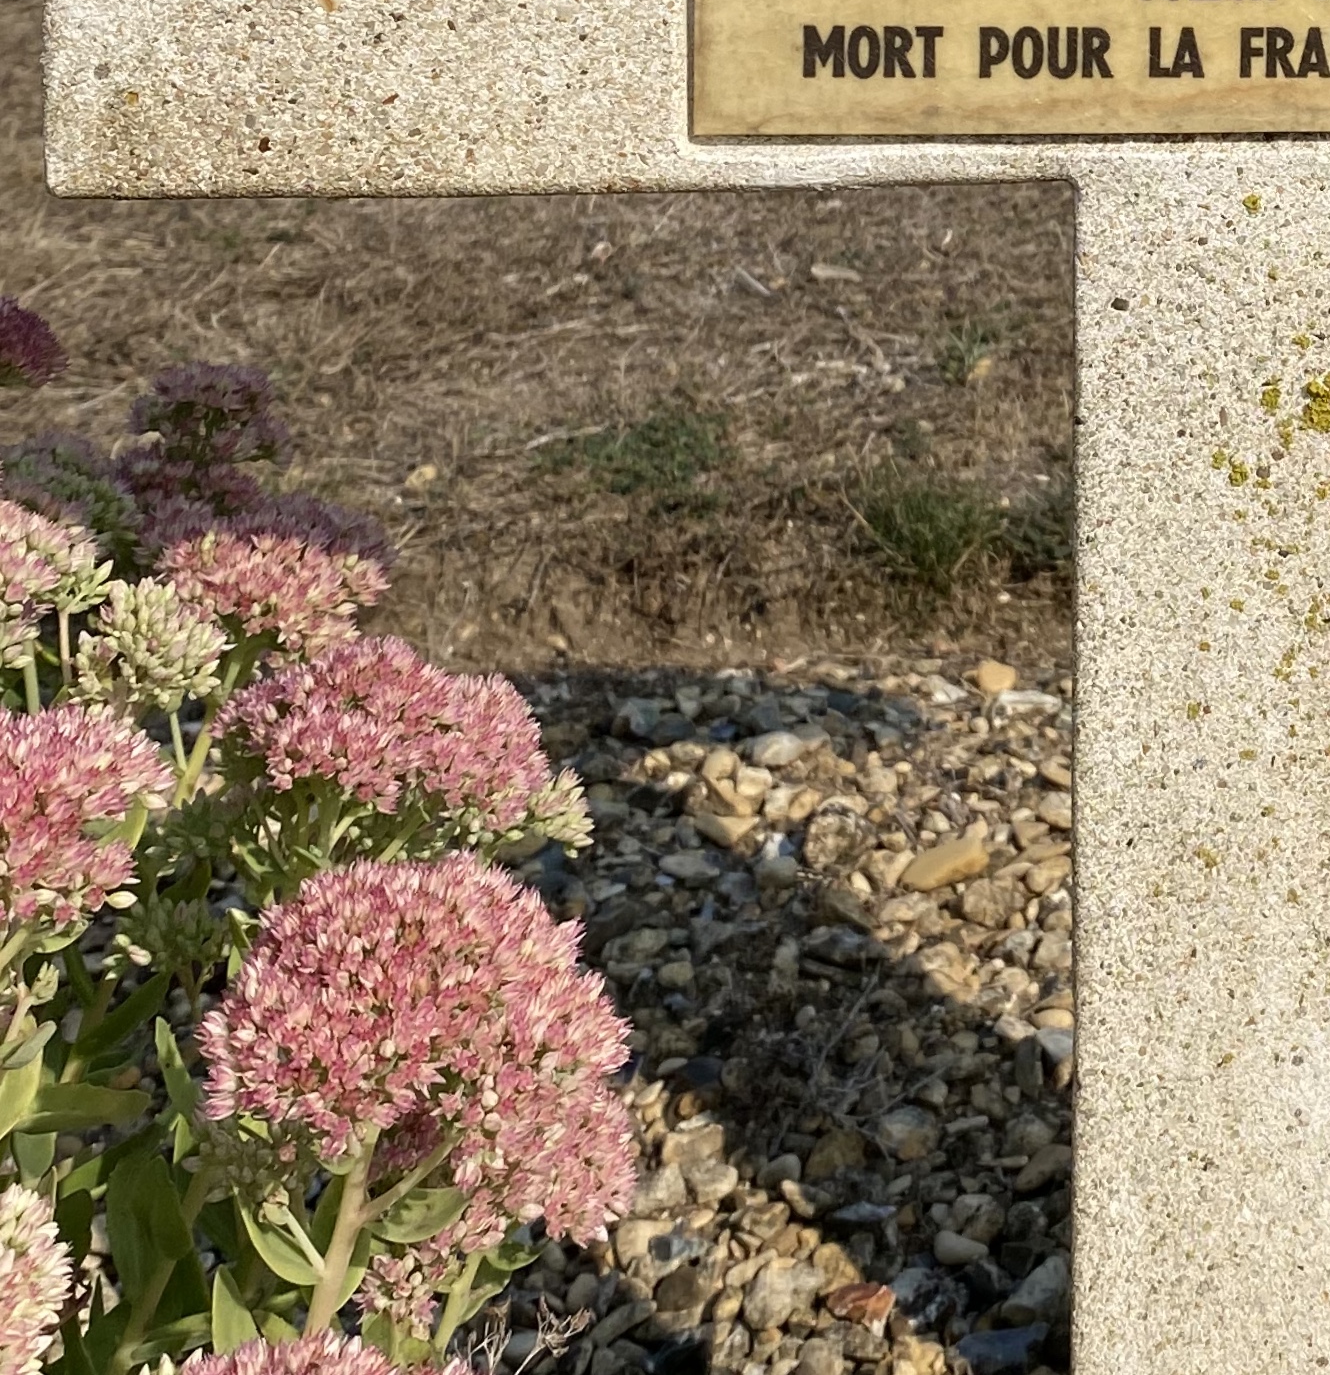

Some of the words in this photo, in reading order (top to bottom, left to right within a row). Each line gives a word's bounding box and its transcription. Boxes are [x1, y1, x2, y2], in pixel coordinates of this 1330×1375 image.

[802, 25, 945, 80] MORT
[978, 26, 1115, 80] POUR
[1147, 26, 1206, 80] LA
